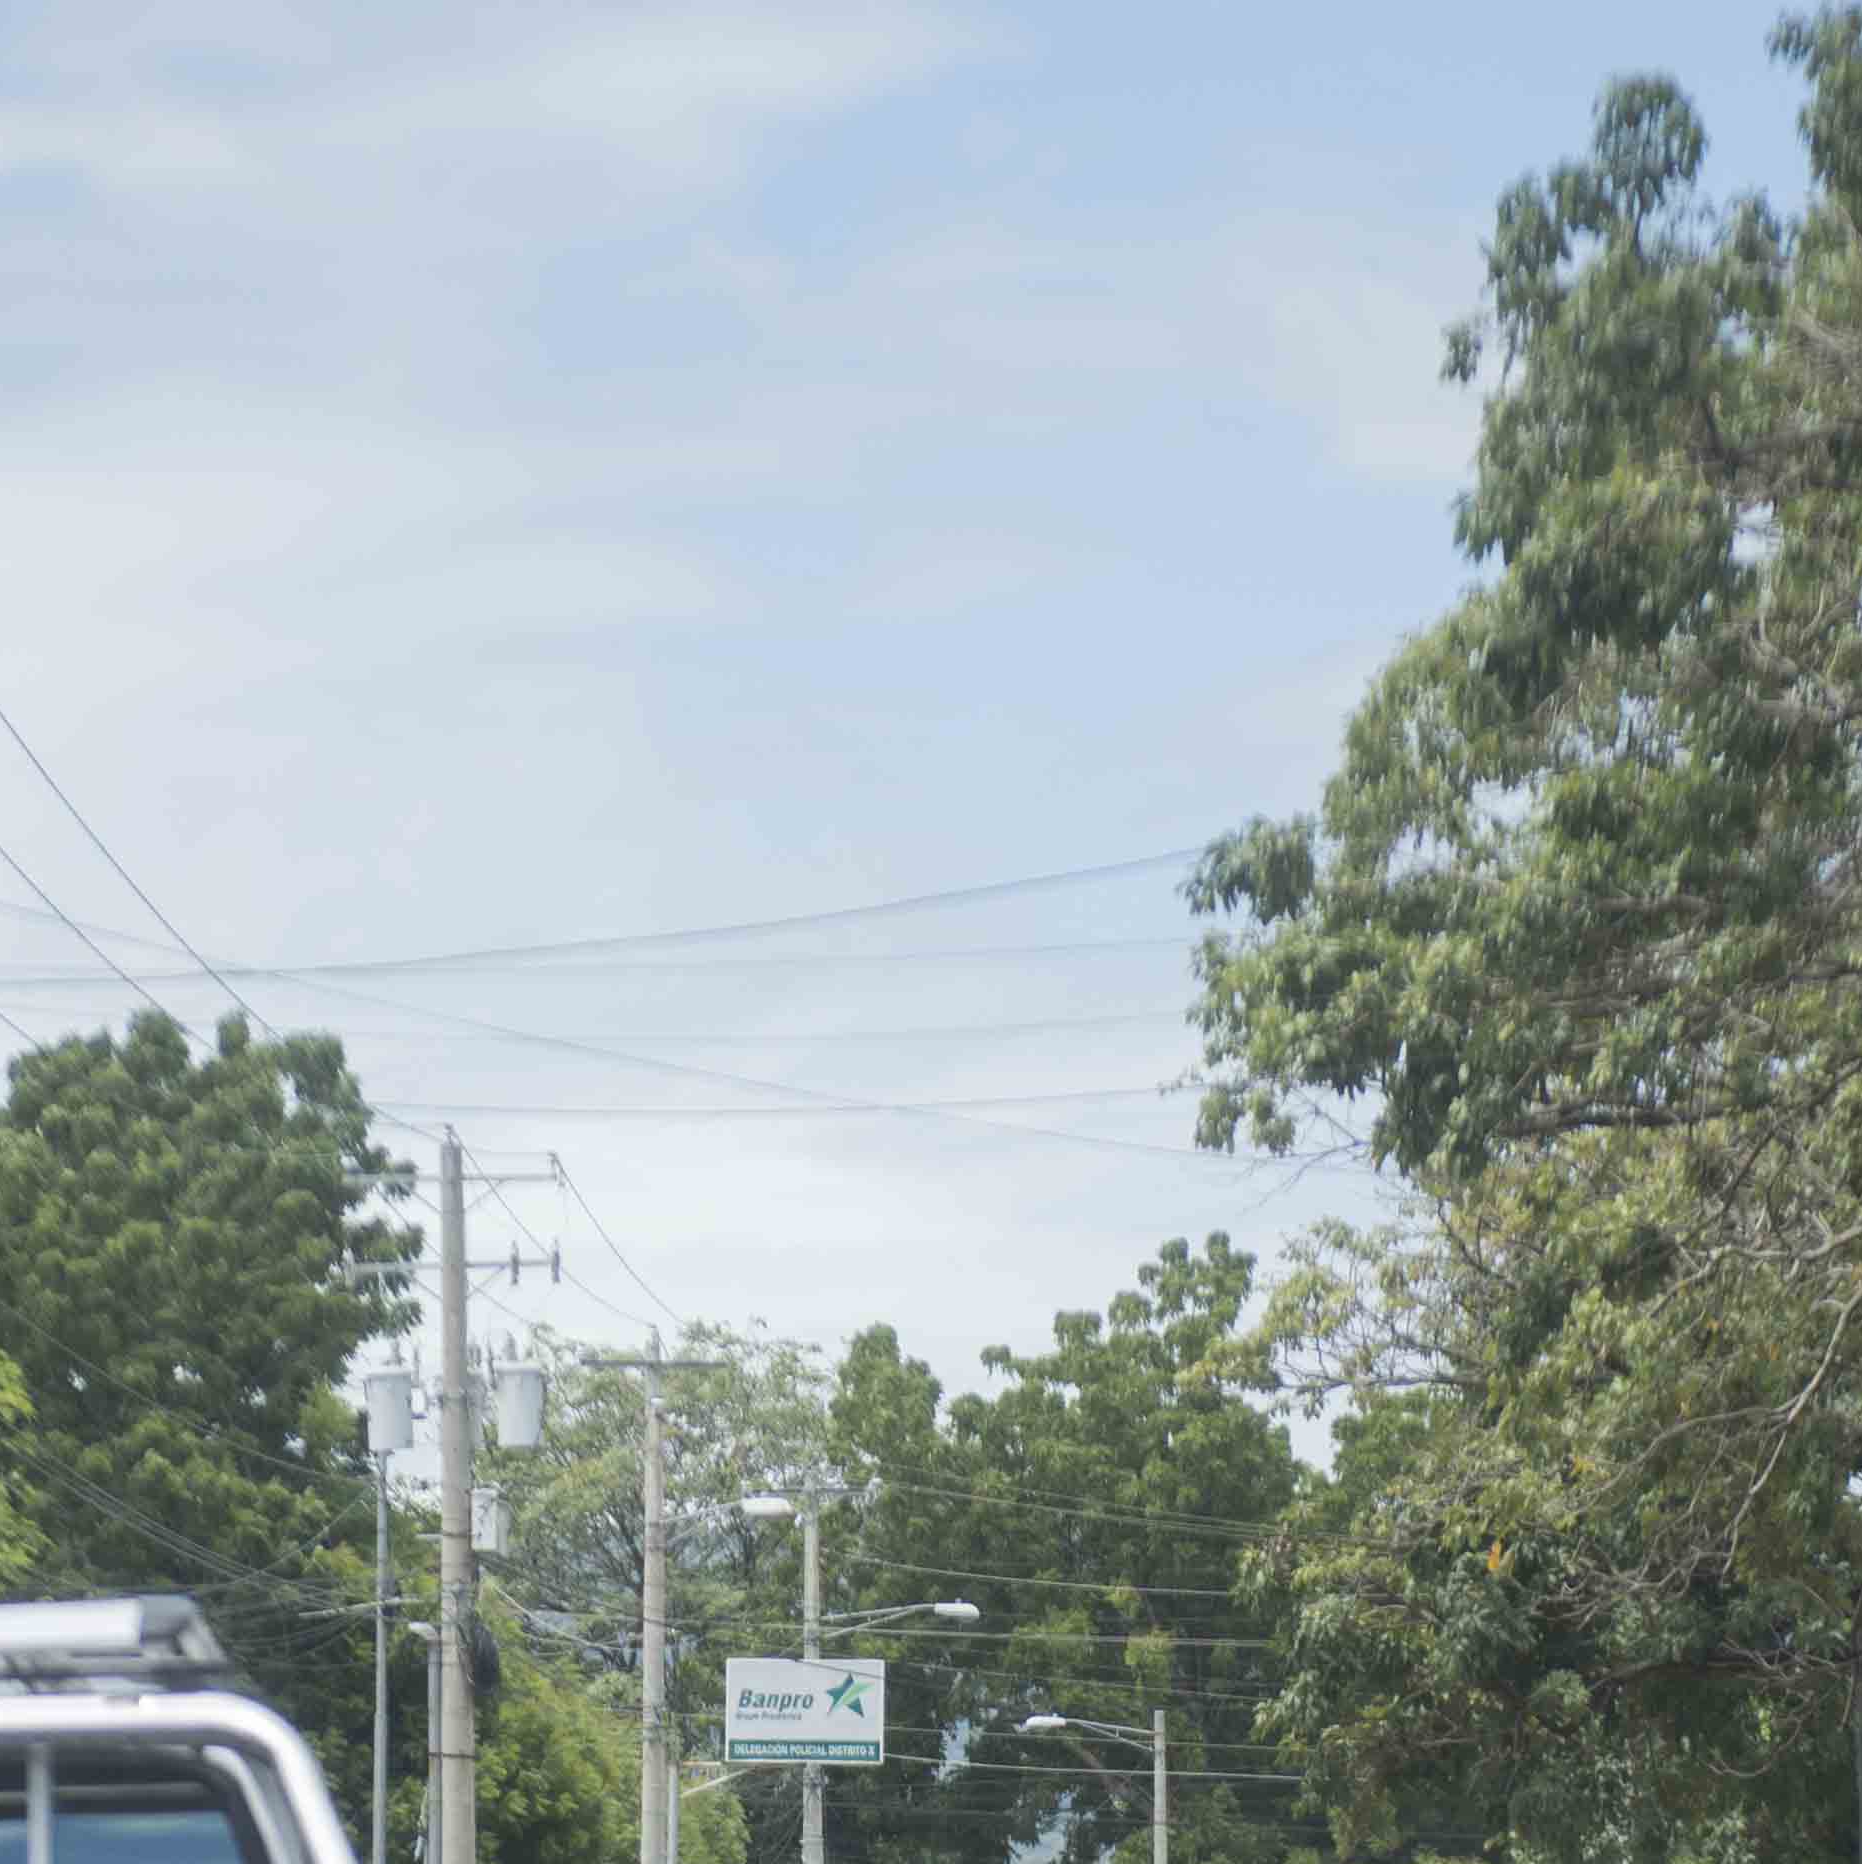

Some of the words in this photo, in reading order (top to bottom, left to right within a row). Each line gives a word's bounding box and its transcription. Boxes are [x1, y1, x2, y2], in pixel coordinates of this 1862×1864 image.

[738, 1687, 814, 1712] Banpro
[789, 1743, 827, 1756] POLICIAL
[827, 1744, 866, 1757] DISTRITO
